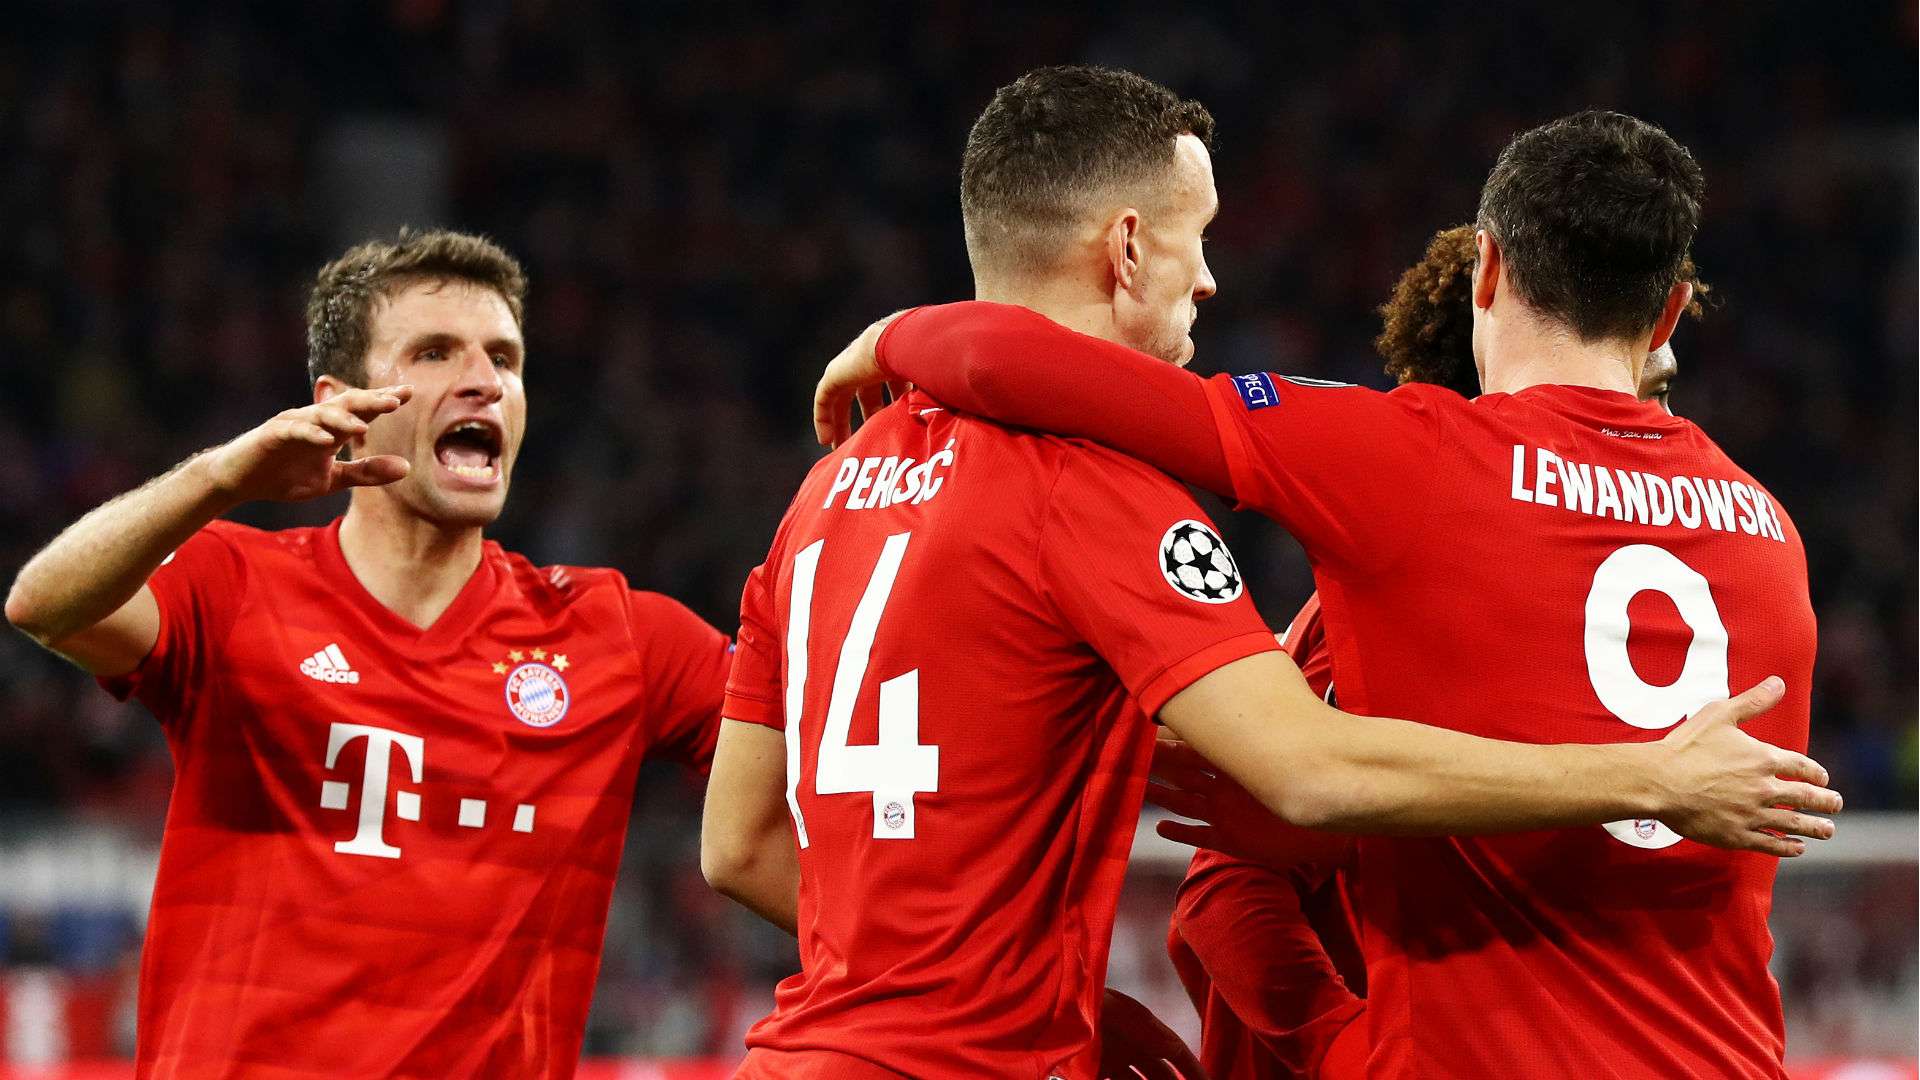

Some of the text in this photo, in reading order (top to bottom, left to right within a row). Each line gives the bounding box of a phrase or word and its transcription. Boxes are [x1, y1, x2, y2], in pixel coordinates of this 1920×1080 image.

[1241, 373, 1269, 406] PECT
[1511, 445, 1786, 543] LEWANDOWSKI
[299, 662, 360, 685] adidas
[785, 531, 939, 850] 14
[1584, 543, 1729, 850] 9
